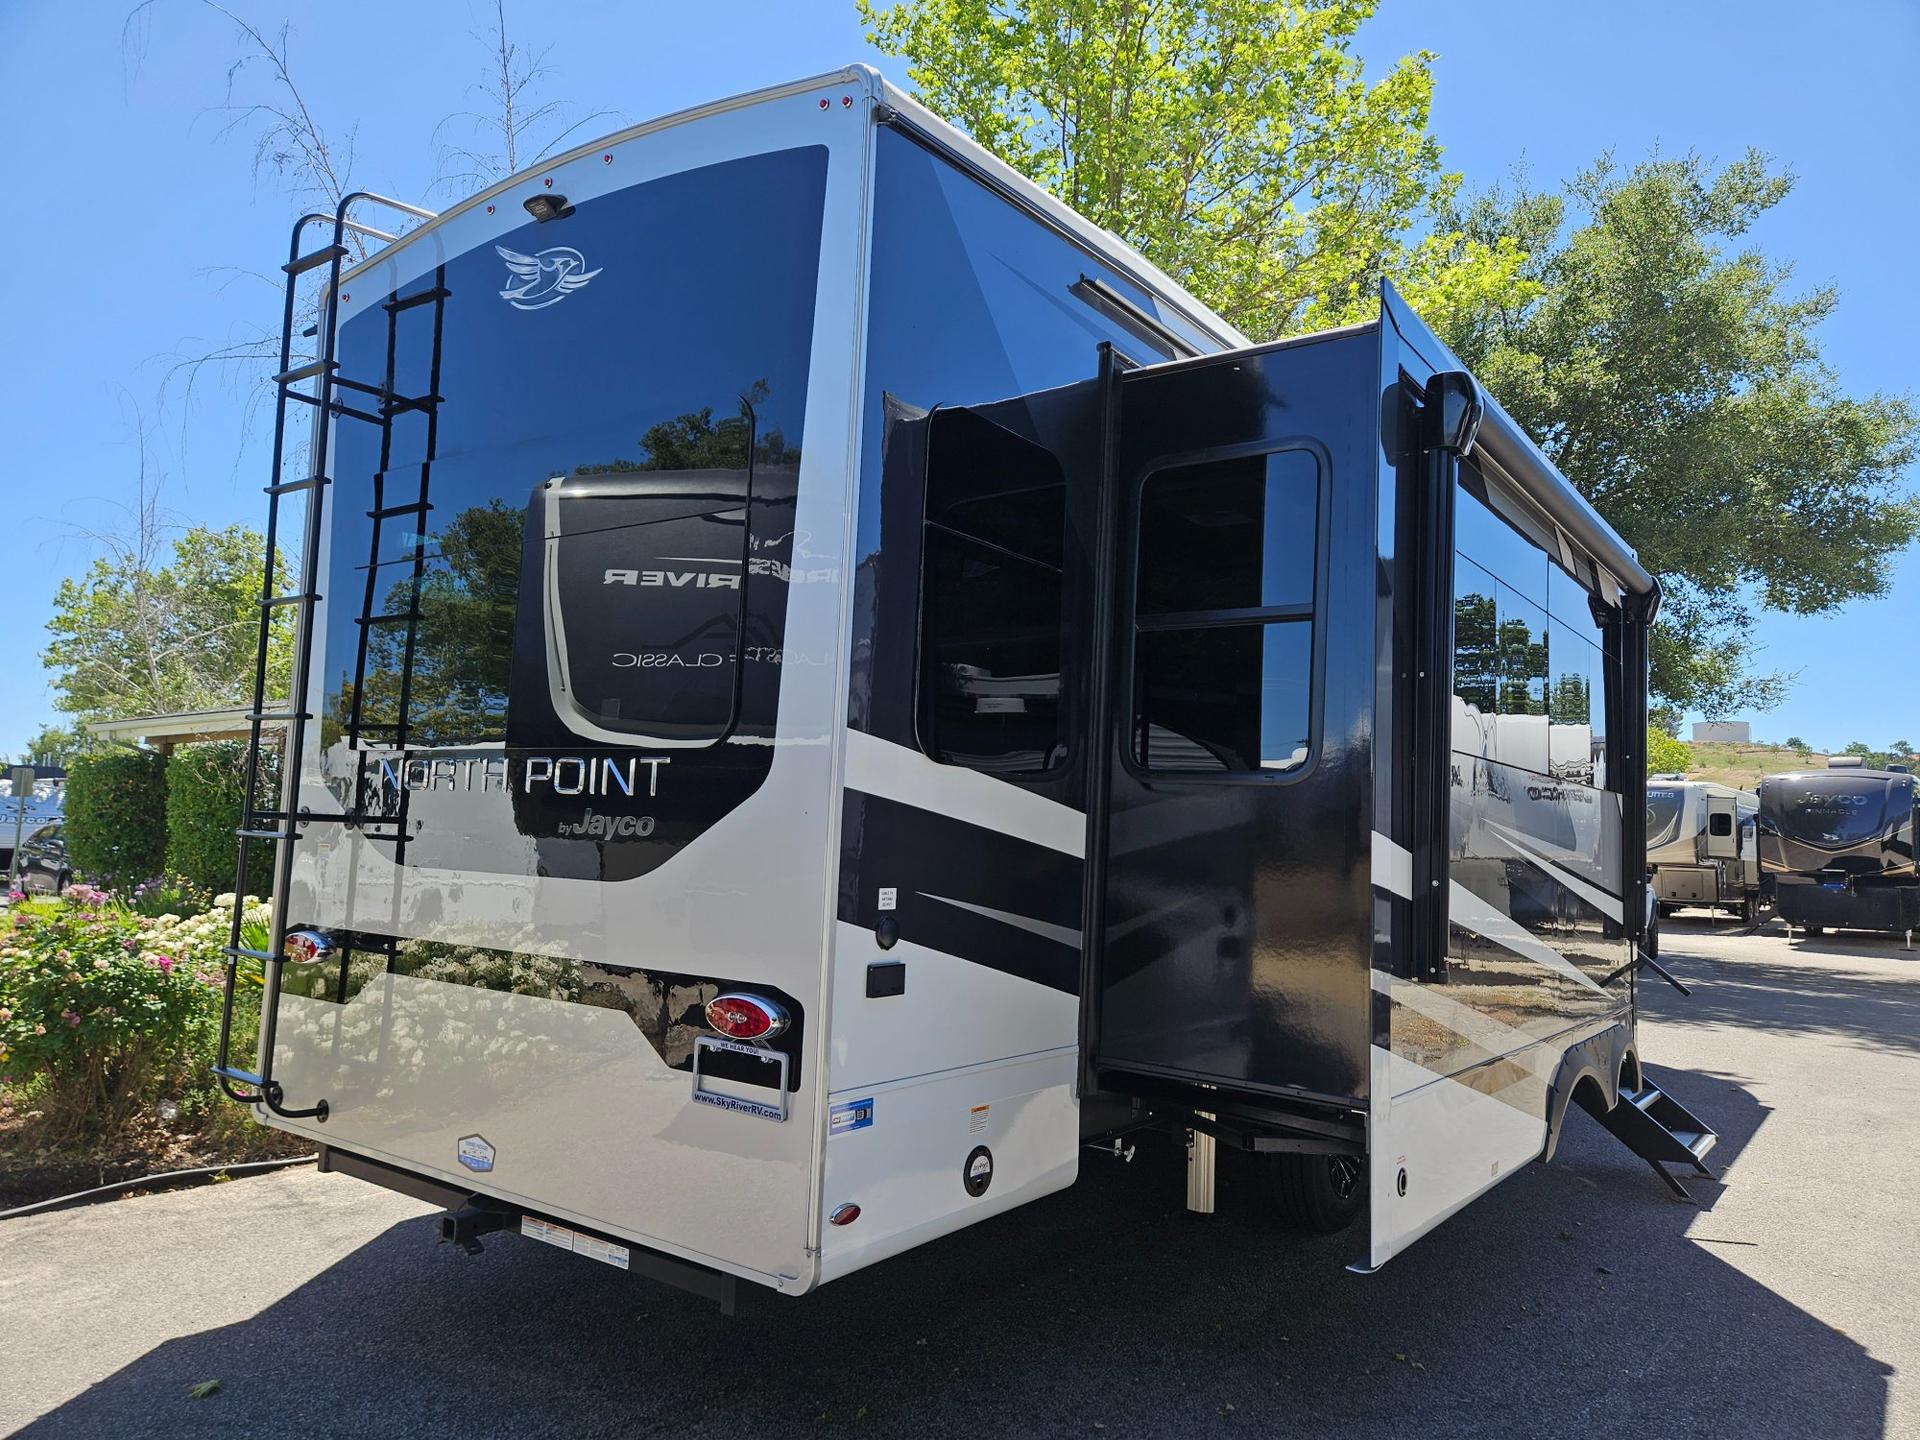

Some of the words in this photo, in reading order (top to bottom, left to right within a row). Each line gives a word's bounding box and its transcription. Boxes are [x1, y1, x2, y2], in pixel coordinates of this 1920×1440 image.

[379, 757, 511, 793] NORTH
[525, 756, 671, 797] POINT
[0, 814, 48, 825] Jaco
[557, 821, 573, 836] by
[573, 807, 656, 841] Jayco
[694, 1093, 781, 1120] www.SkyRiverRV.com
